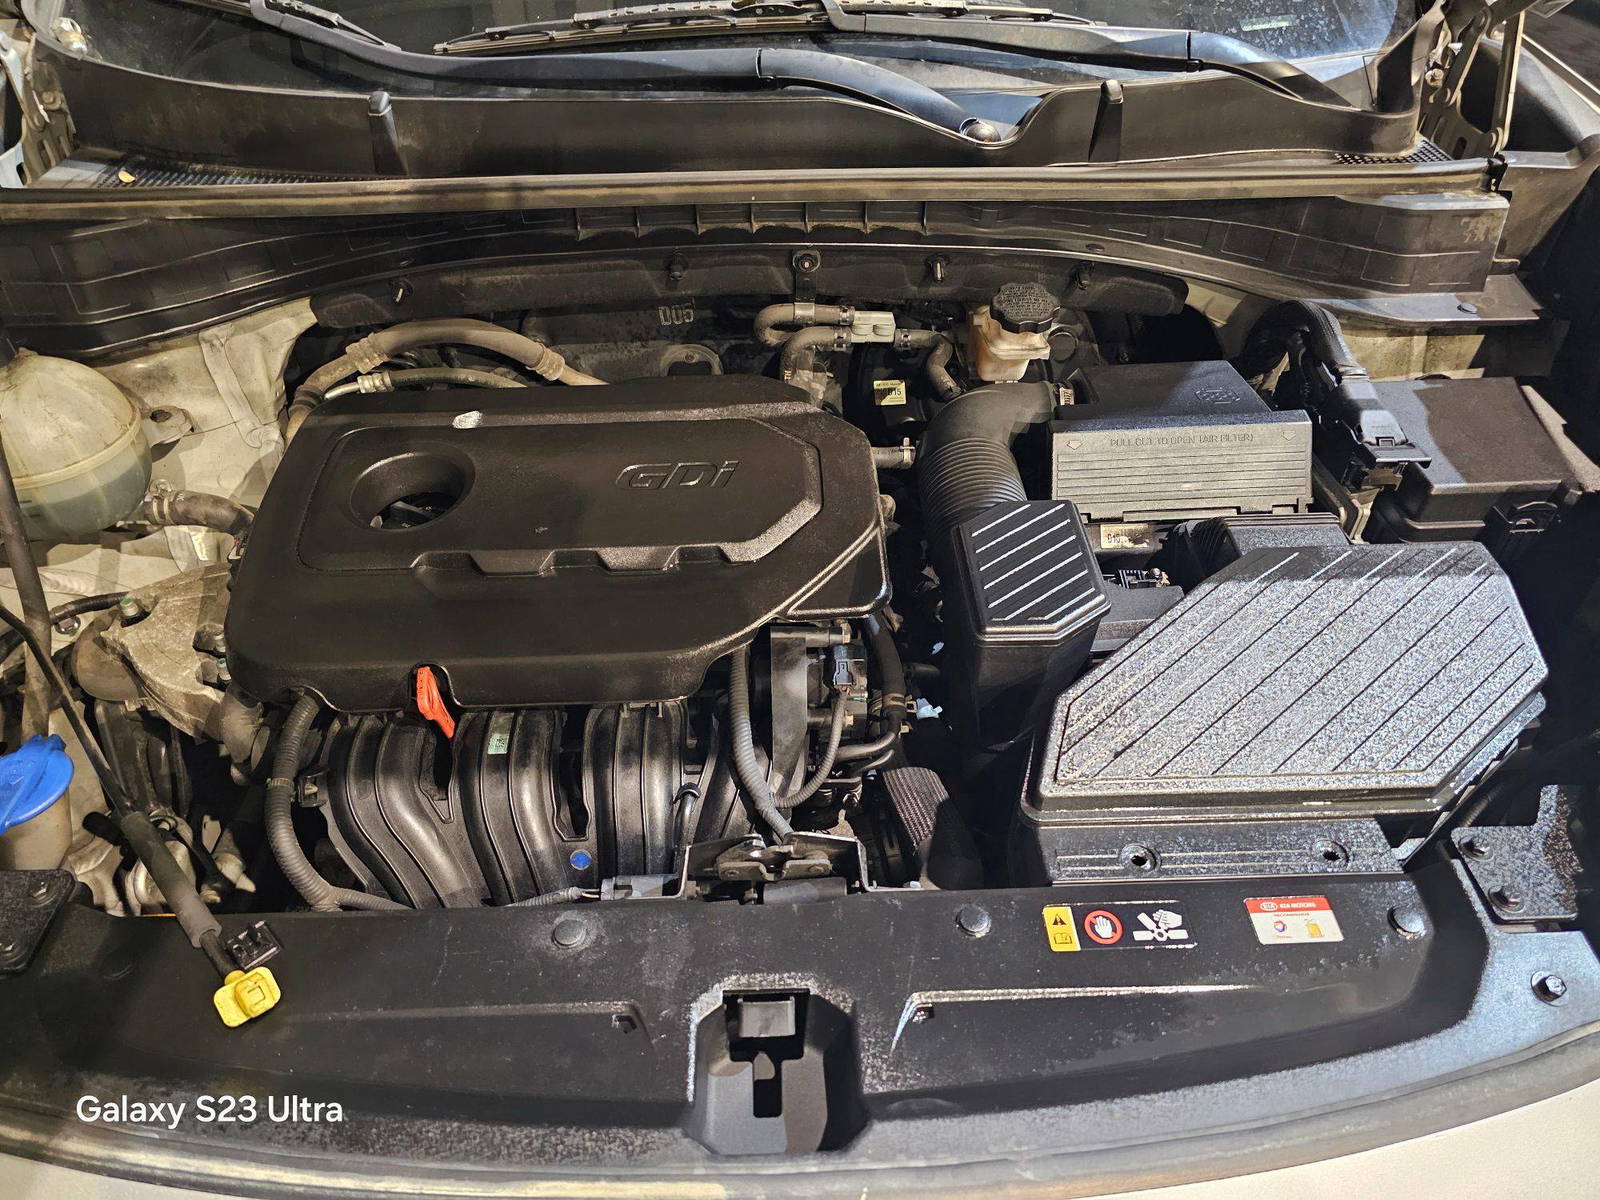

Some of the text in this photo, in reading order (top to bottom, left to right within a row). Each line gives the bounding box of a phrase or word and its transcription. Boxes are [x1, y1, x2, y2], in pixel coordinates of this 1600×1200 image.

[1109, 432, 1254, 447] PULL OUT TO OPEN (AIR FILTER)
[615, 459, 740, 490] GDi
